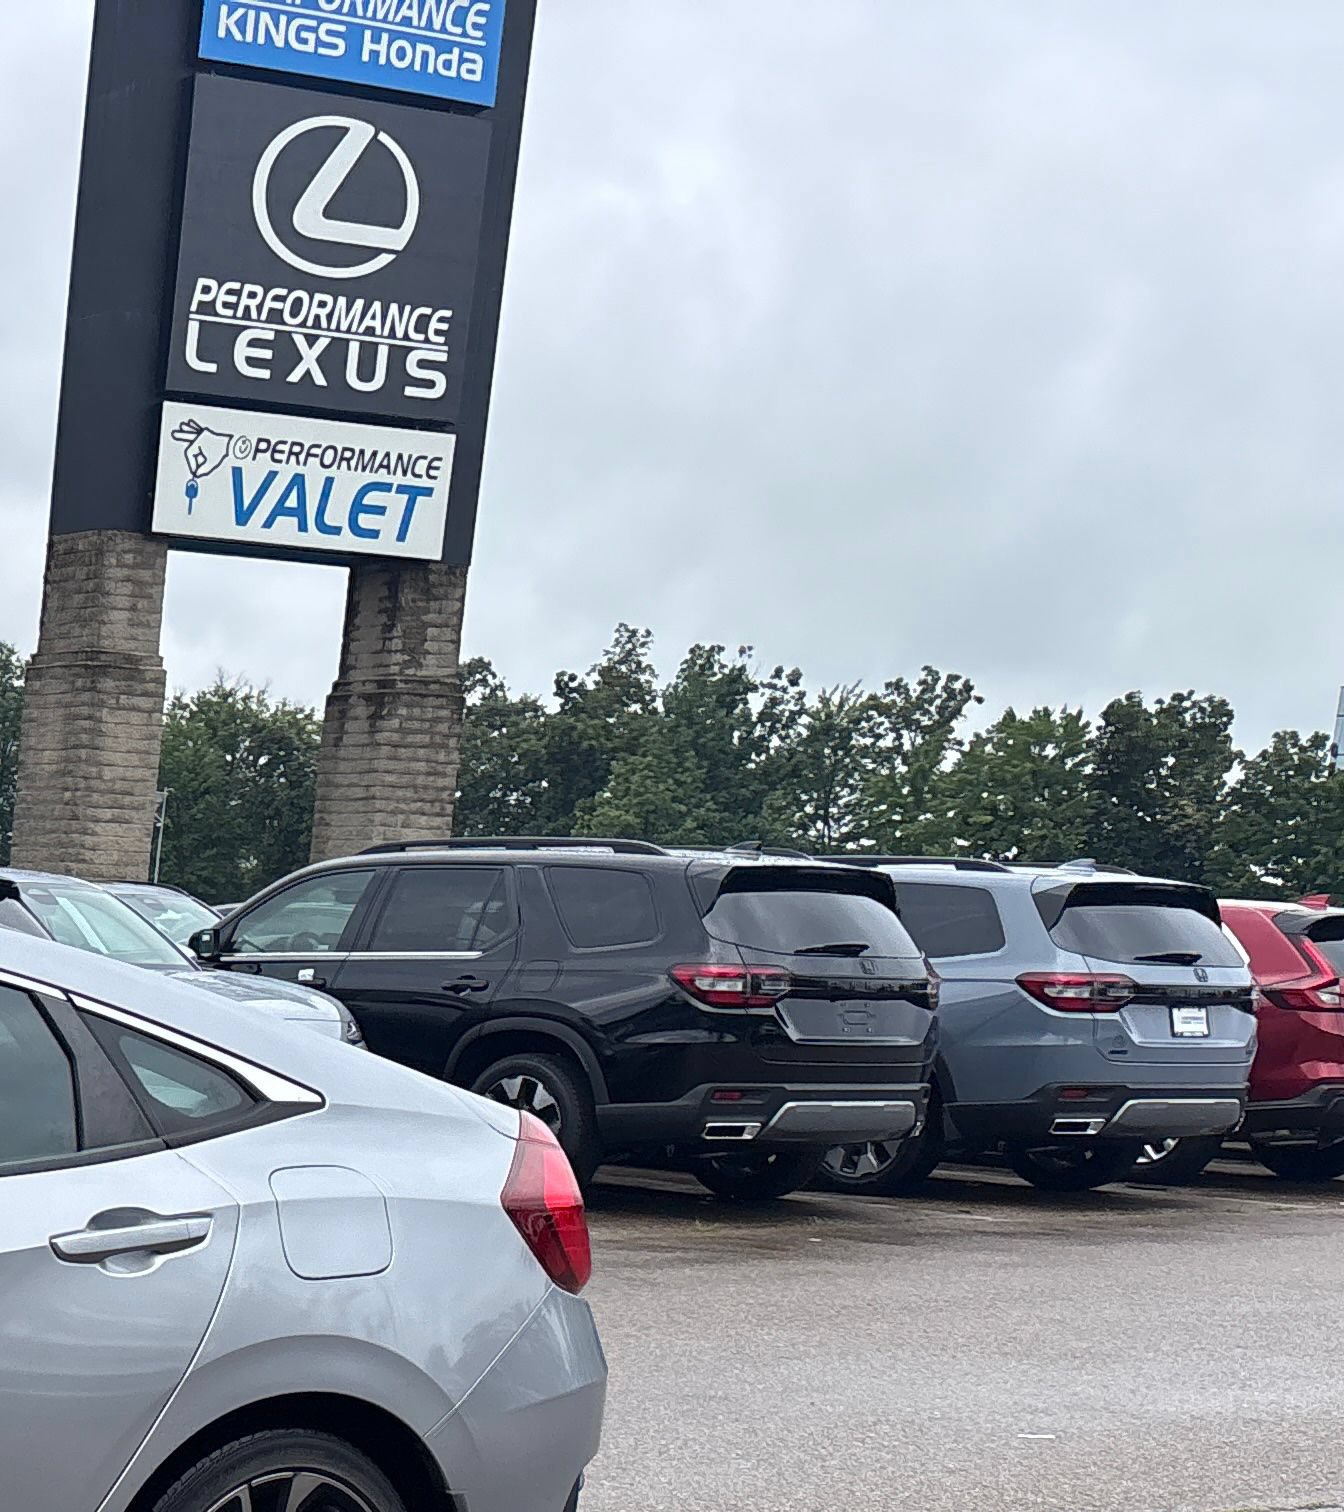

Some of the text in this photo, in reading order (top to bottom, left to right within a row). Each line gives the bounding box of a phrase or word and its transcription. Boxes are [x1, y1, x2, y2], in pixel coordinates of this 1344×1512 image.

[217, 4, 483, 82] KINGS Honda
[189, 277, 453, 344] PERFORMANCE
[185, 319, 449, 400] LEXUS
[251, 437, 443, 481] PERFORMANCE
[231, 466, 435, 543] VALET
